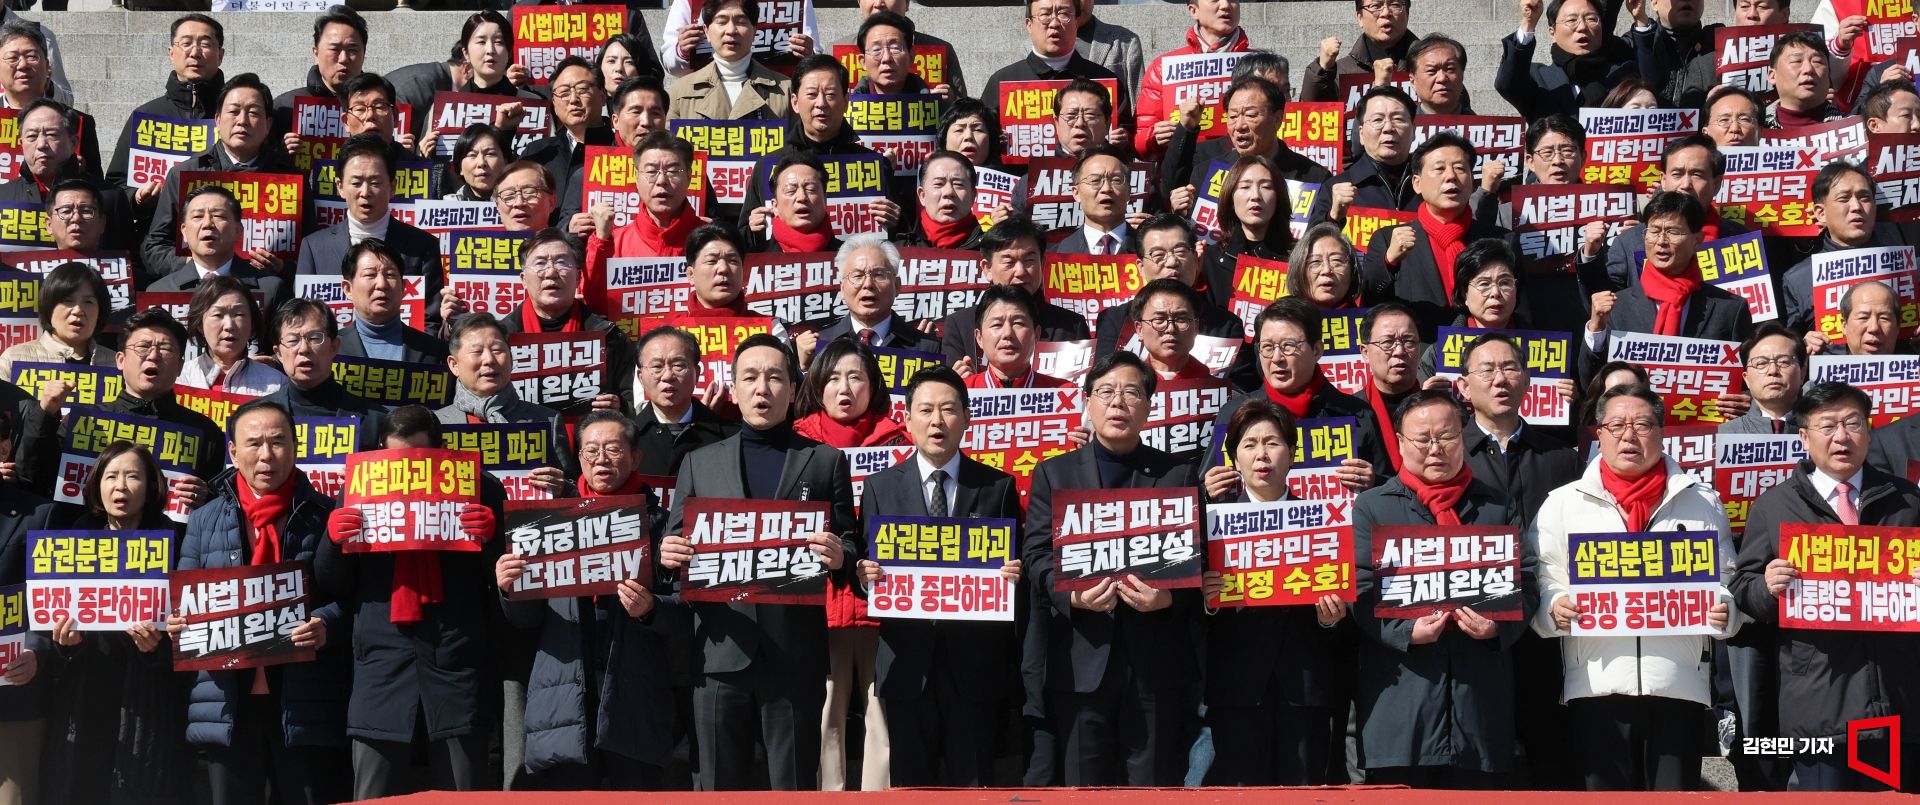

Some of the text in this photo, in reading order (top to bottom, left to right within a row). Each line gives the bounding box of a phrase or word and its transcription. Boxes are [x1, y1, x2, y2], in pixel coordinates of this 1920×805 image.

[518, 13, 587, 41] 사법파괴
[1721, 36, 1774, 65] 사법
[914, 54, 942, 84] 3법
[1166, 64, 1221, 81] 사법파괴
[908, 102, 940, 129] 파괴
[1005, 90, 1056, 119] 사법파
[136, 120, 207, 151] 삼권분립
[1308, 111, 1339, 141] 3법
[1469, 124, 1521, 149] 파괴
[1587, 113, 1676, 134] 사법파괴 악법
[750, 127, 783, 155] 파괴
[1007, 124, 1055, 157] 대통령은
[1592, 138, 1669, 162] 대한민
[846, 161, 881, 191] 파괴
[1725, 152, 1794, 172] 파괴 악법
[396, 168, 429, 199] 파괴
[983, 172, 1011, 191] 악법
[265, 183, 297, 213] 3법
[1521, 192, 1637, 223] 사법 파괴
[419, 210, 478, 226] 사법파괴
[1344, 218, 1397, 245] 사법
[1521, 228, 1573, 259] 독재
[1722, 239, 1763, 274] 파괴
[611, 264, 674, 285] 사법파괴
[747, 262, 842, 293] 사법 파
[896, 259, 986, 286] 사법 파
[1049, 262, 1147, 293] 사법파괴 3
[1238, 266, 1288, 300] 사법
[1817, 254, 1876, 282] 사법파괴
[0, 280, 39, 312] 파괴
[302, 284, 348, 300] 사법파
[455, 282, 489, 313] 당장
[623, 288, 688, 313] 대한민
[511, 339, 603, 373] 법 파괴
[1527, 339, 1567, 373] 파괴
[1613, 342, 1720, 363] 사법파괴 악법
[409, 371, 449, 404] 파괴
[543, 371, 600, 403] 완성
[1647, 370, 1730, 394] 한민국
[1815, 363, 1884, 384] 사법파괴
[967, 392, 1054, 417] 법파괴 악법
[1147, 387, 1227, 421] 법 파괴
[1521, 383, 1564, 417] 하라!
[1672, 400, 1719, 422] 수호
[160, 431, 199, 468] 파괴
[314, 424, 355, 458] 파괴
[507, 430, 547, 463] 파괴
[962, 420, 1067, 450] 대한민국
[1311, 424, 1352, 461] 파괴
[855, 452, 889, 472] 악법
[1720, 442, 1809, 464] 사법파괴 악
[350, 458, 432, 497] 사법파괴
[440, 459, 475, 496] 3법
[349, 502, 405, 543] 통령은
[691, 511, 826, 544] 사법 파괴
[1062, 497, 1195, 536] 사법 파괴
[1212, 506, 1322, 536] 사법파괴 악법
[32, 537, 169, 573] 삼권분립 파괴
[875, 524, 1010, 562] 삼권분립 파괴
[1062, 530, 1195, 577] 독재 완성
[1225, 532, 1339, 569] 대한민국
[1381, 534, 1515, 569] 사법 파괴
[1575, 538, 1715, 578] 삼권분립 파괴
[1788, 535, 1879, 574] 사법파괴
[688, 548, 821, 587] 독재 완성
[1220, 563, 1349, 602] 헌정 수호!
[181, 570, 306, 615] 사법 파괴
[874, 574, 1008, 612] 당장 중단하라!
[1381, 565, 1514, 606] 독재 완성
[1787, 579, 1851, 621] 대통령은
[32, 585, 166, 624] 당장 중단하라!
[1576, 592, 1618, 630] 당장
[179, 603, 306, 658] 독재 완성
